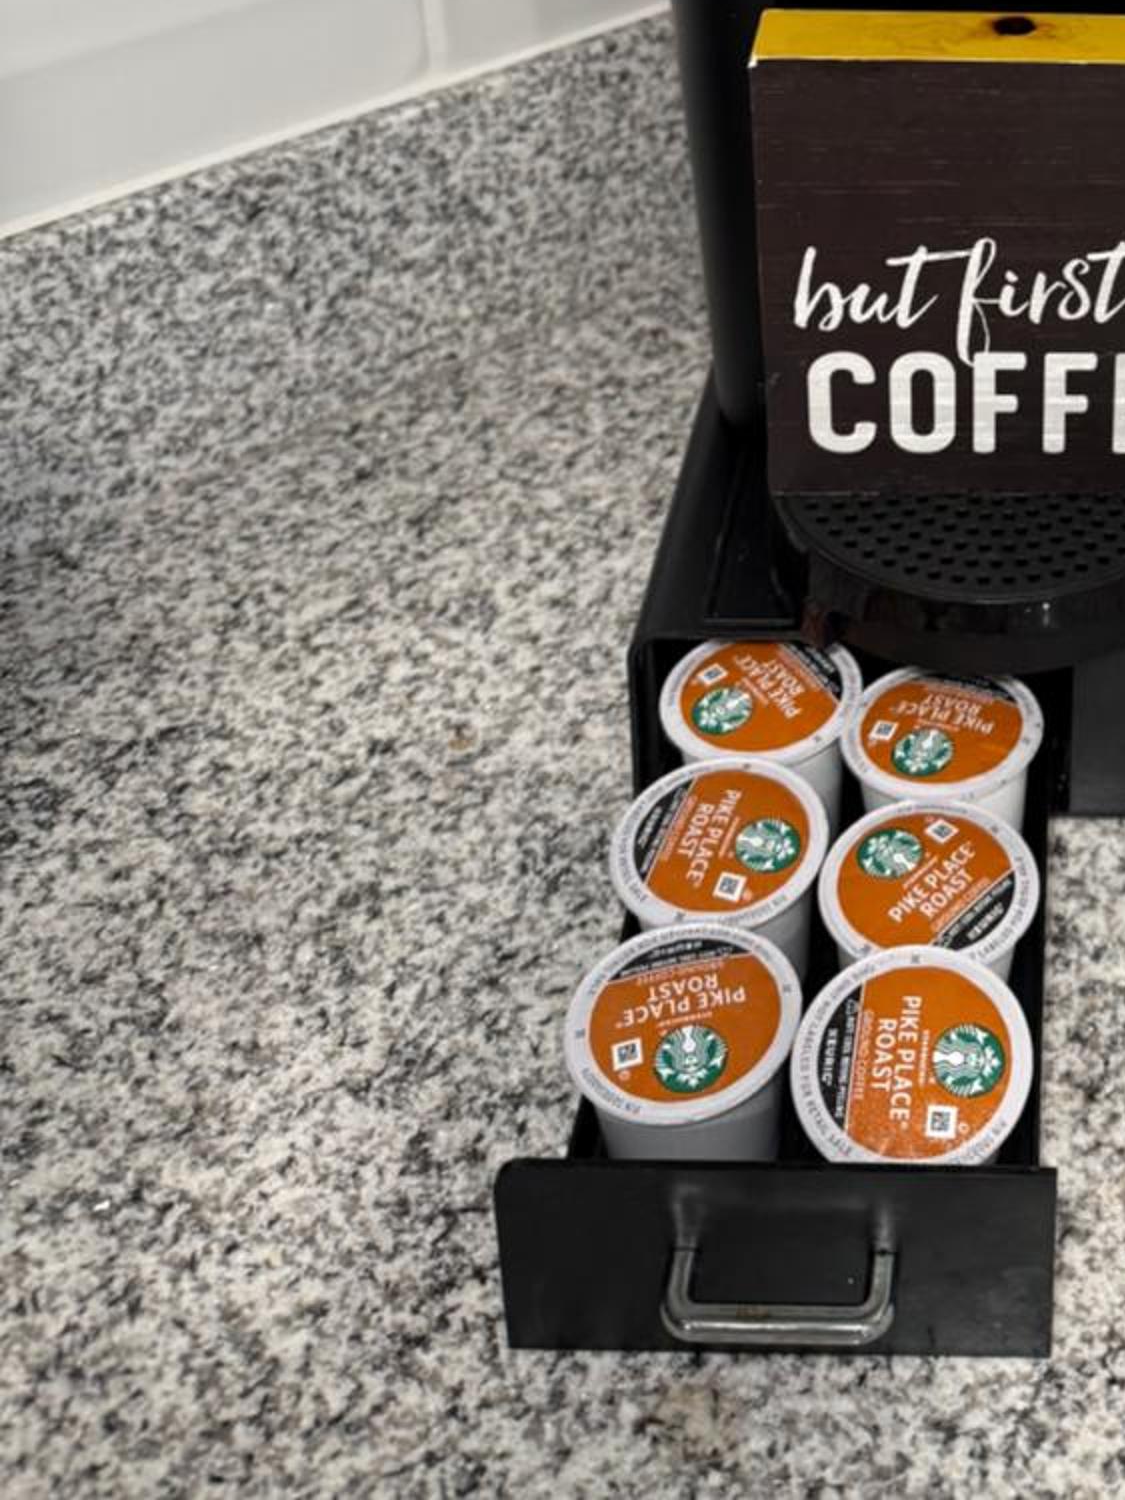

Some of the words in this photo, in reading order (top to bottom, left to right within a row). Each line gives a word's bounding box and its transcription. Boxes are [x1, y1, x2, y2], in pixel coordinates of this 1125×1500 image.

[793, 245, 973, 331] but
[737, 652, 777, 689] PLACE
[762, 658, 805, 695] ROAST
[767, 686, 802, 719] PIKE
[896, 701, 948, 719] PLACE
[925, 694, 980, 713] ROAST
[953, 713, 994, 733] PIKE
[708, 788, 740, 822] PIKE
[676, 803, 712, 858] ROAST
[685, 828, 722, 881] PLACE
[887, 883, 929, 923] PIKE
[924, 840, 977, 891] PLACE
[919, 867, 974, 920] ROAST
[647, 973, 717, 1000] ROAST
[697, 985, 745, 1007] PIKE
[622, 994, 690, 1024] PLACE
[897, 995, 921, 1043] PIKE
[821, 1028, 837, 1085] KEURIG
[871, 1018, 896, 1092] ROAST
[888, 1049, 914, 1122] PLACE
